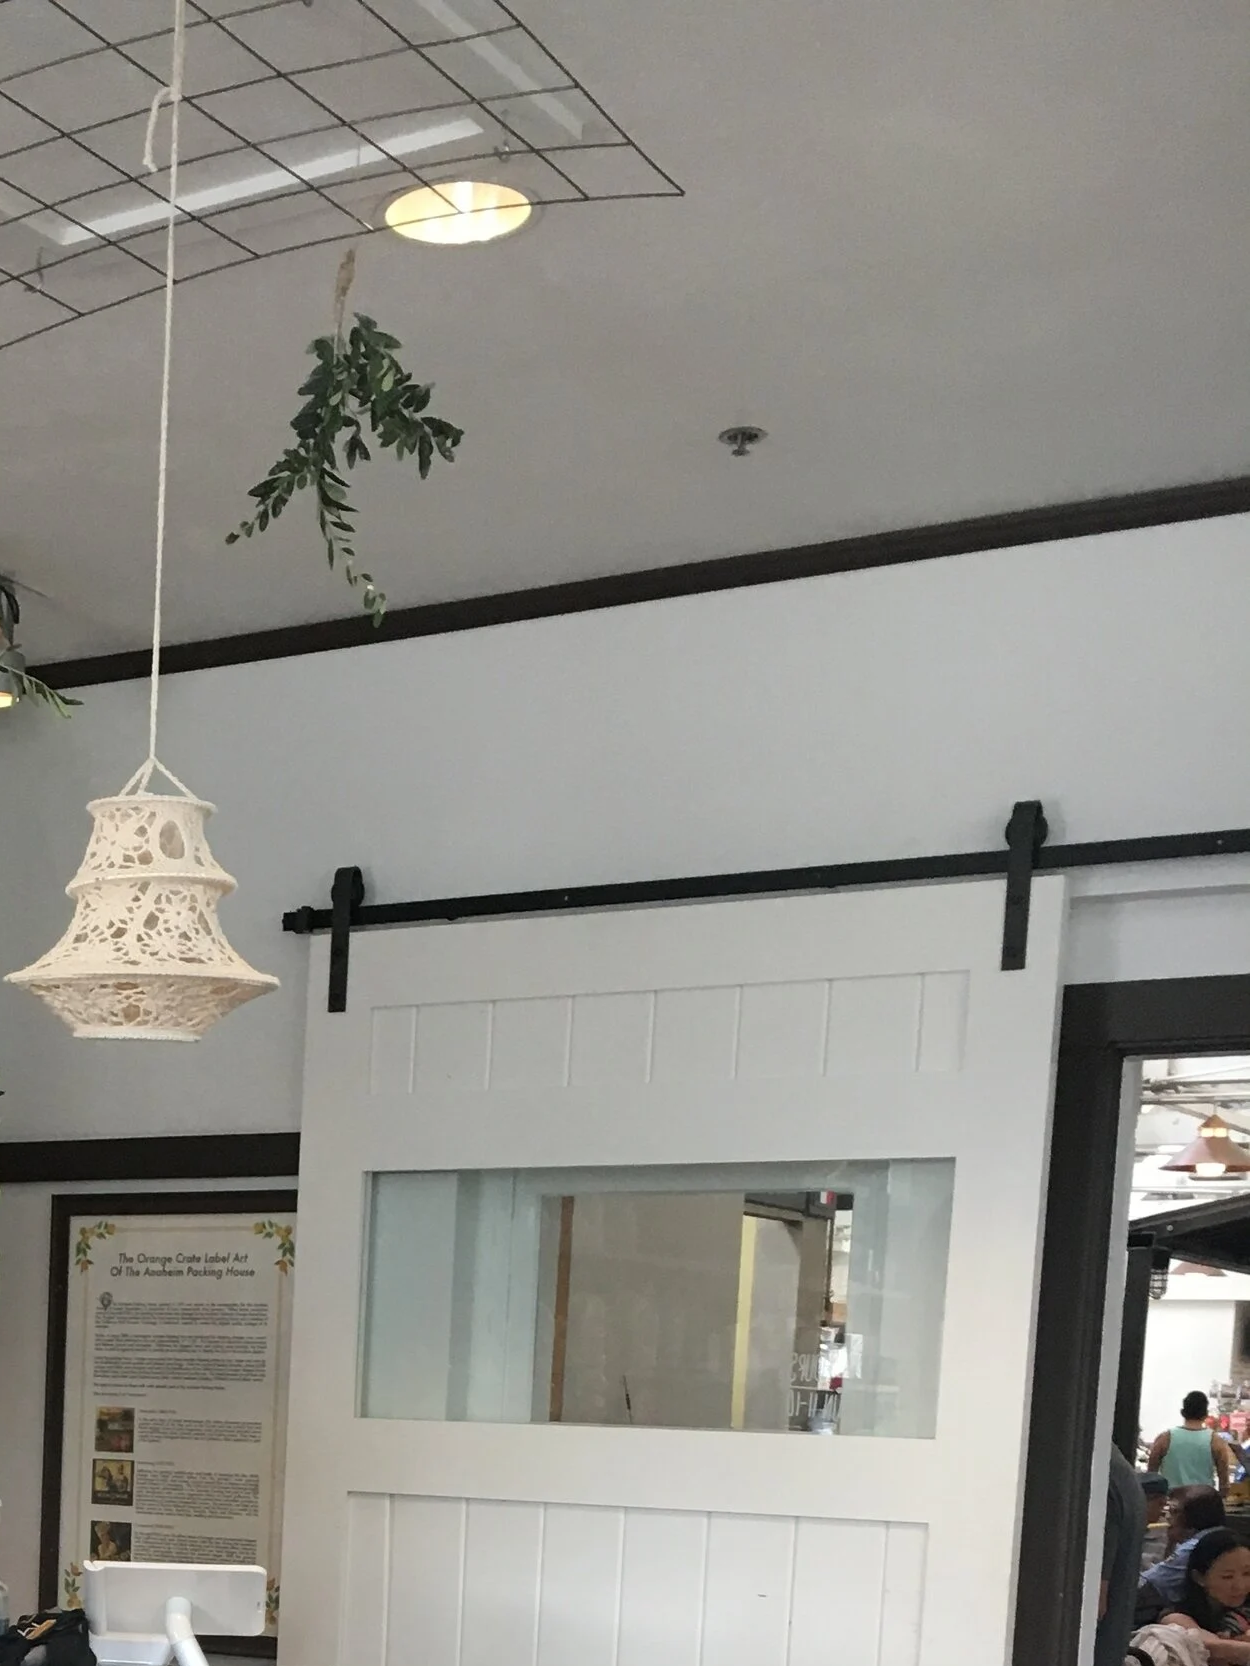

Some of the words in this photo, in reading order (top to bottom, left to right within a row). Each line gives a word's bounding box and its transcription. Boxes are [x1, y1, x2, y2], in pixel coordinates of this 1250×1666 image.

[118, 1253, 134, 1263] The
[137, 1253, 173, 1266] Orange
[175, 1253, 201, 1263] Crate
[204, 1252, 230, 1263] Label
[232, 1252, 248, 1263] Art
[110, 1266, 123, 1277] Of
[125, 1266, 140, 1276] The
[143, 1266, 184, 1277] Anaheim
[186, 1266, 223, 1280] Packing
[225, 1266, 256, 1277] House
